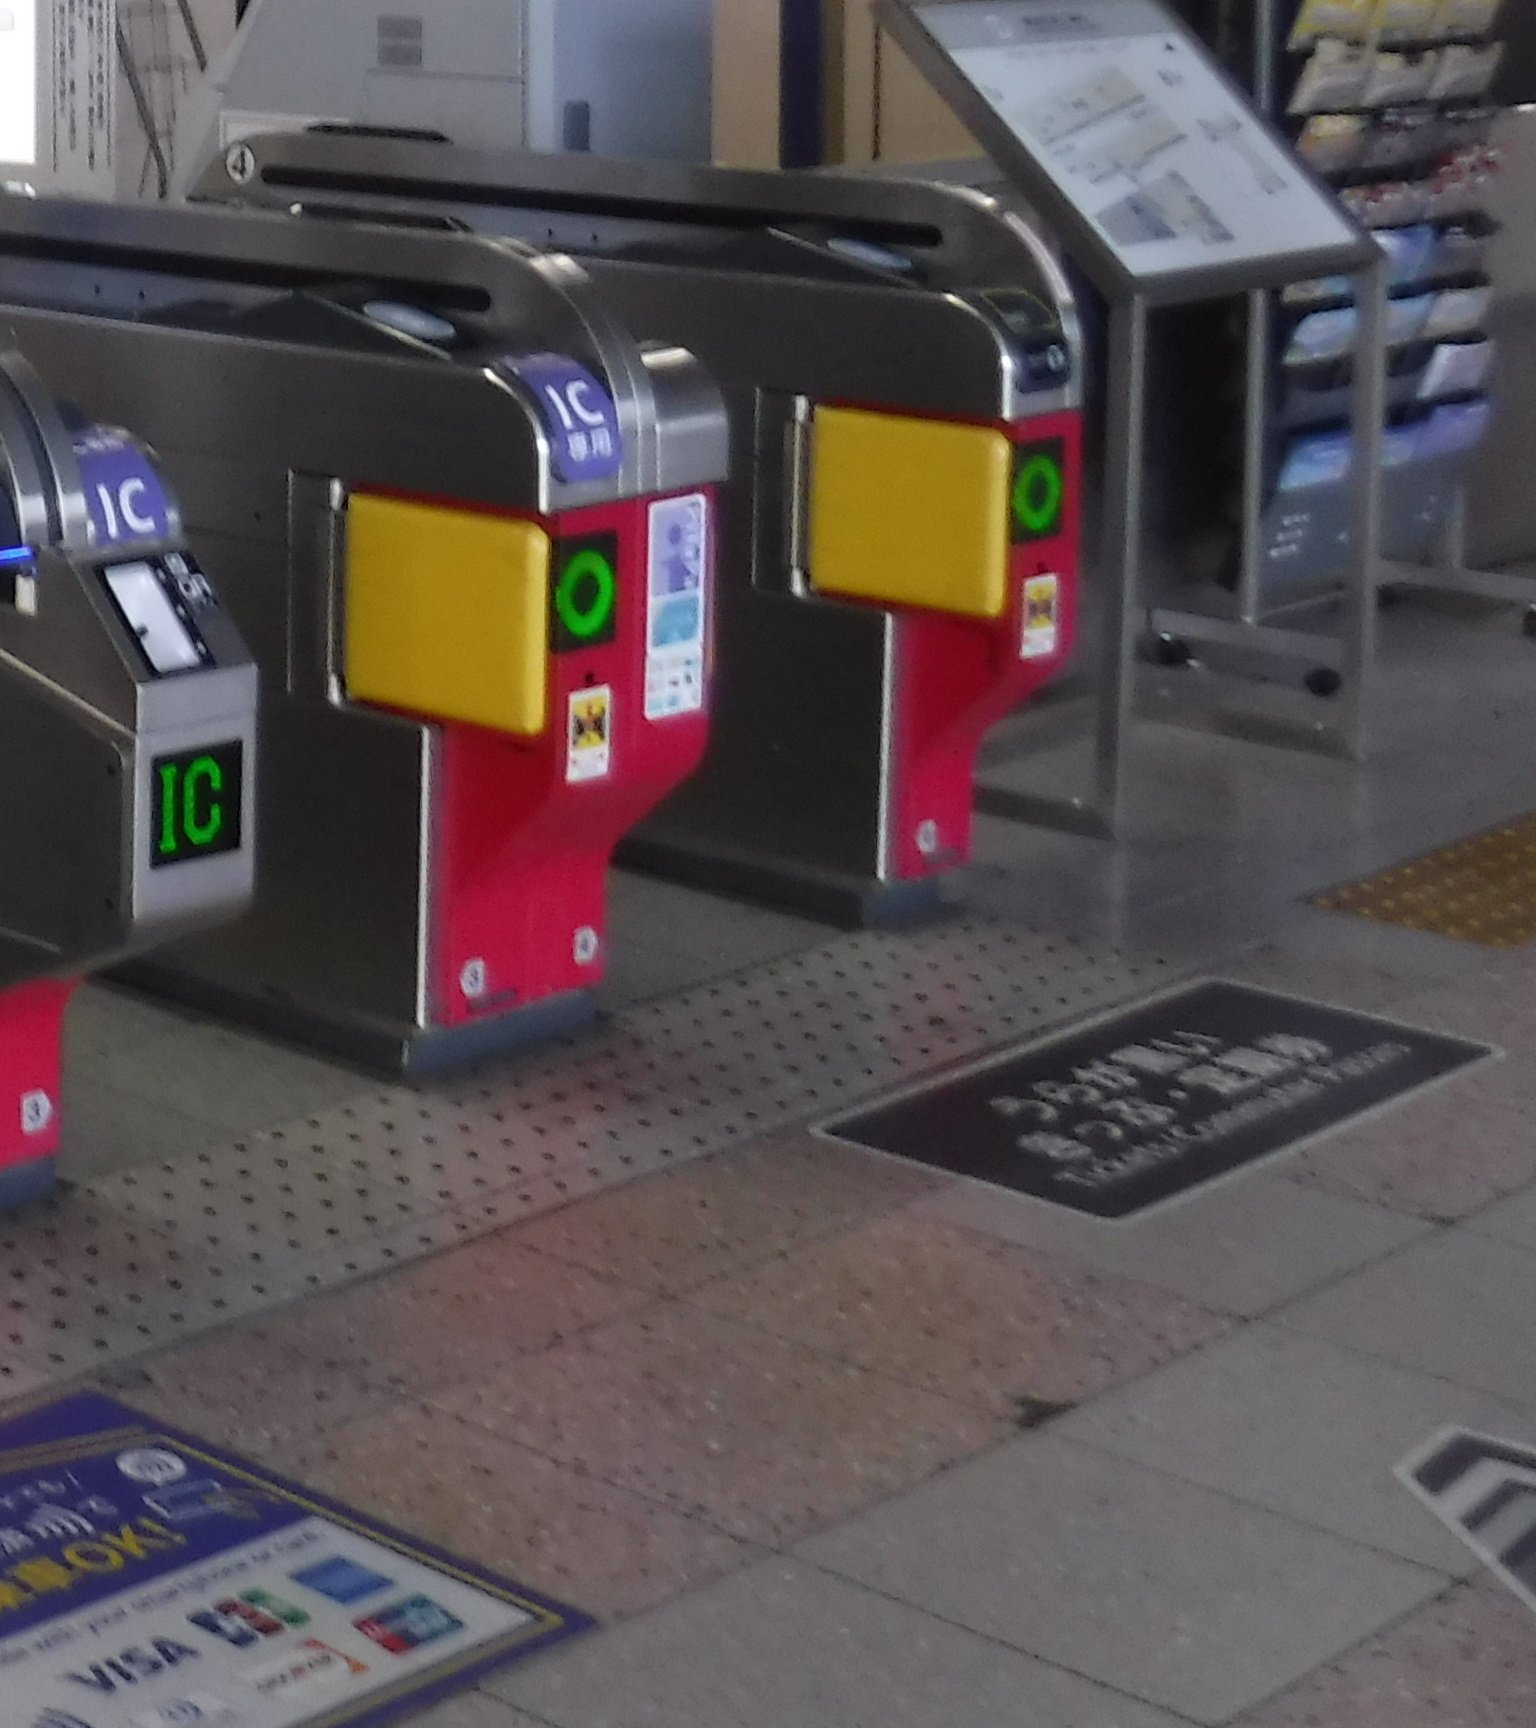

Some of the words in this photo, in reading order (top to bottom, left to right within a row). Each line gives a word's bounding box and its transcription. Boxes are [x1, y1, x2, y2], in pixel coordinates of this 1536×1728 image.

[232, 146, 249, 178] 4
[544, 379, 605, 430] IC
[567, 428, 612, 463] 専用
[94, 477, 156, 540] IC
[157, 755, 223, 854] IC
[65, 1636, 202, 1692] VISA
